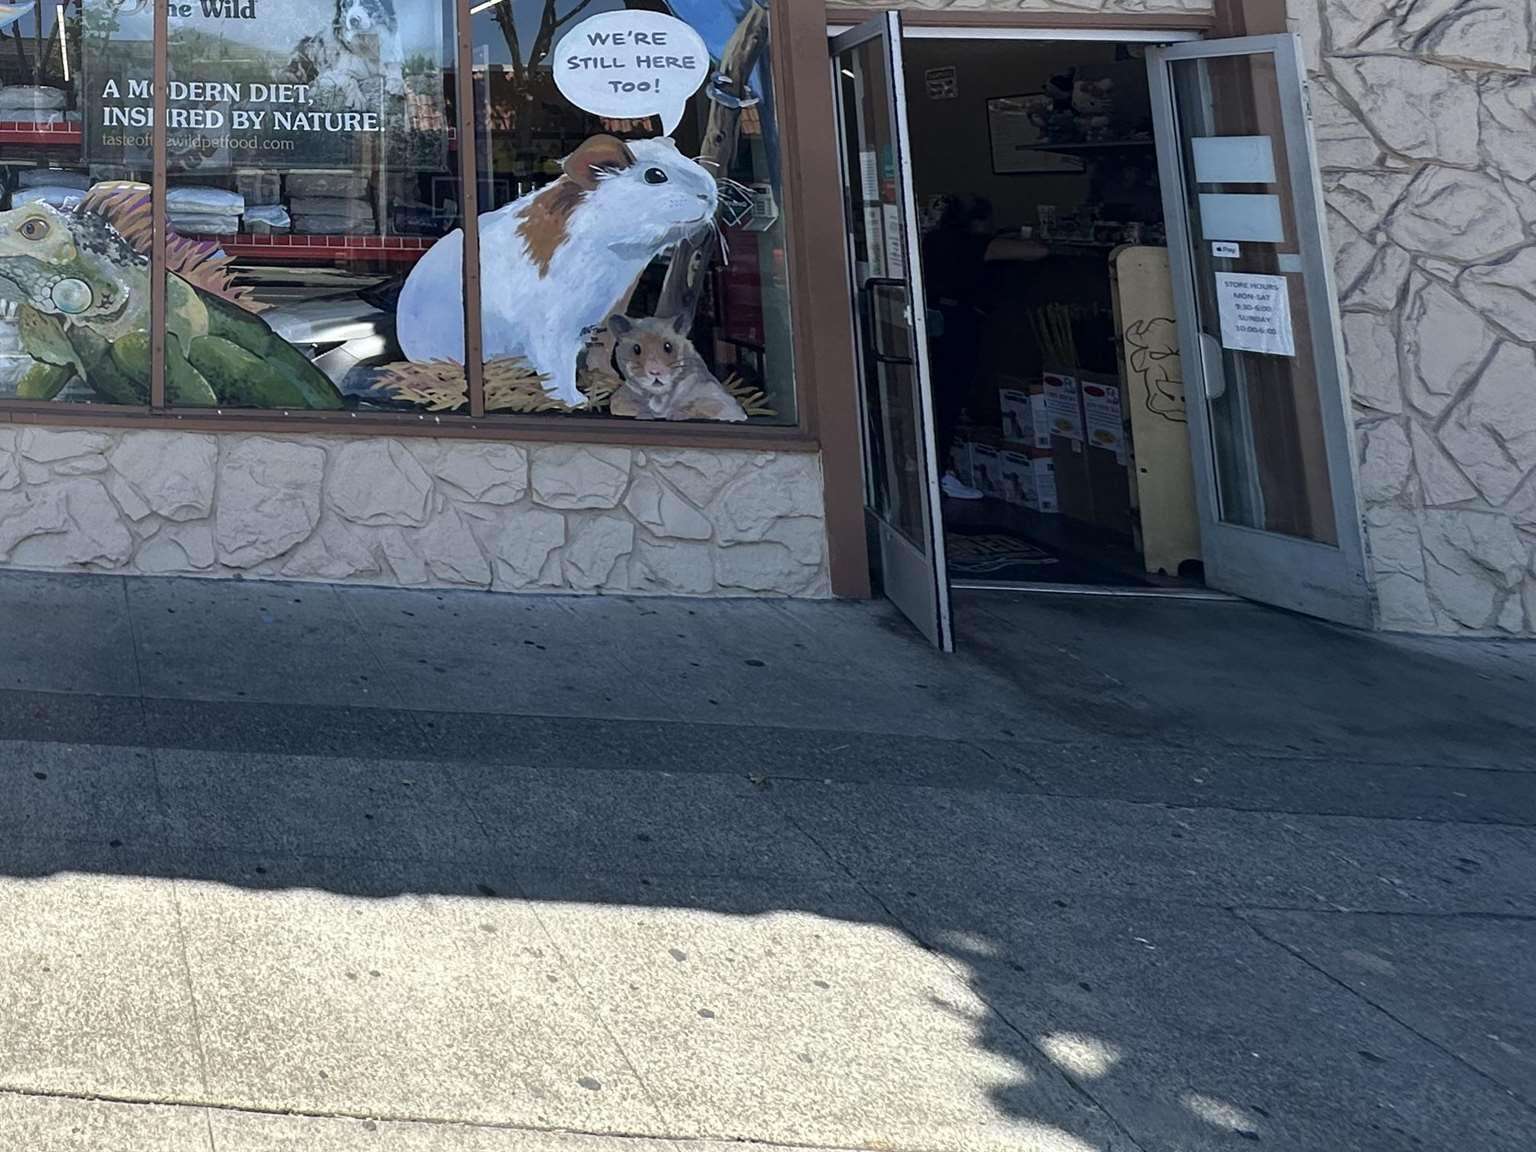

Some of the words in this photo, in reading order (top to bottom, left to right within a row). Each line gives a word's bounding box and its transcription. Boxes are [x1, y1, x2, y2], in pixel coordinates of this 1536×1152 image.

[200, 0, 257, 20] Wild
[587, 30, 668, 46] WE'RE
[567, 55, 626, 71] STILL
[636, 55, 696, 70] HERE
[102, 79, 120, 99] A
[249, 83, 314, 106] DIET,
[608, 78, 661, 94] TOO!
[232, 110, 266, 130] BY
[273, 112, 386, 132] NATURE.
